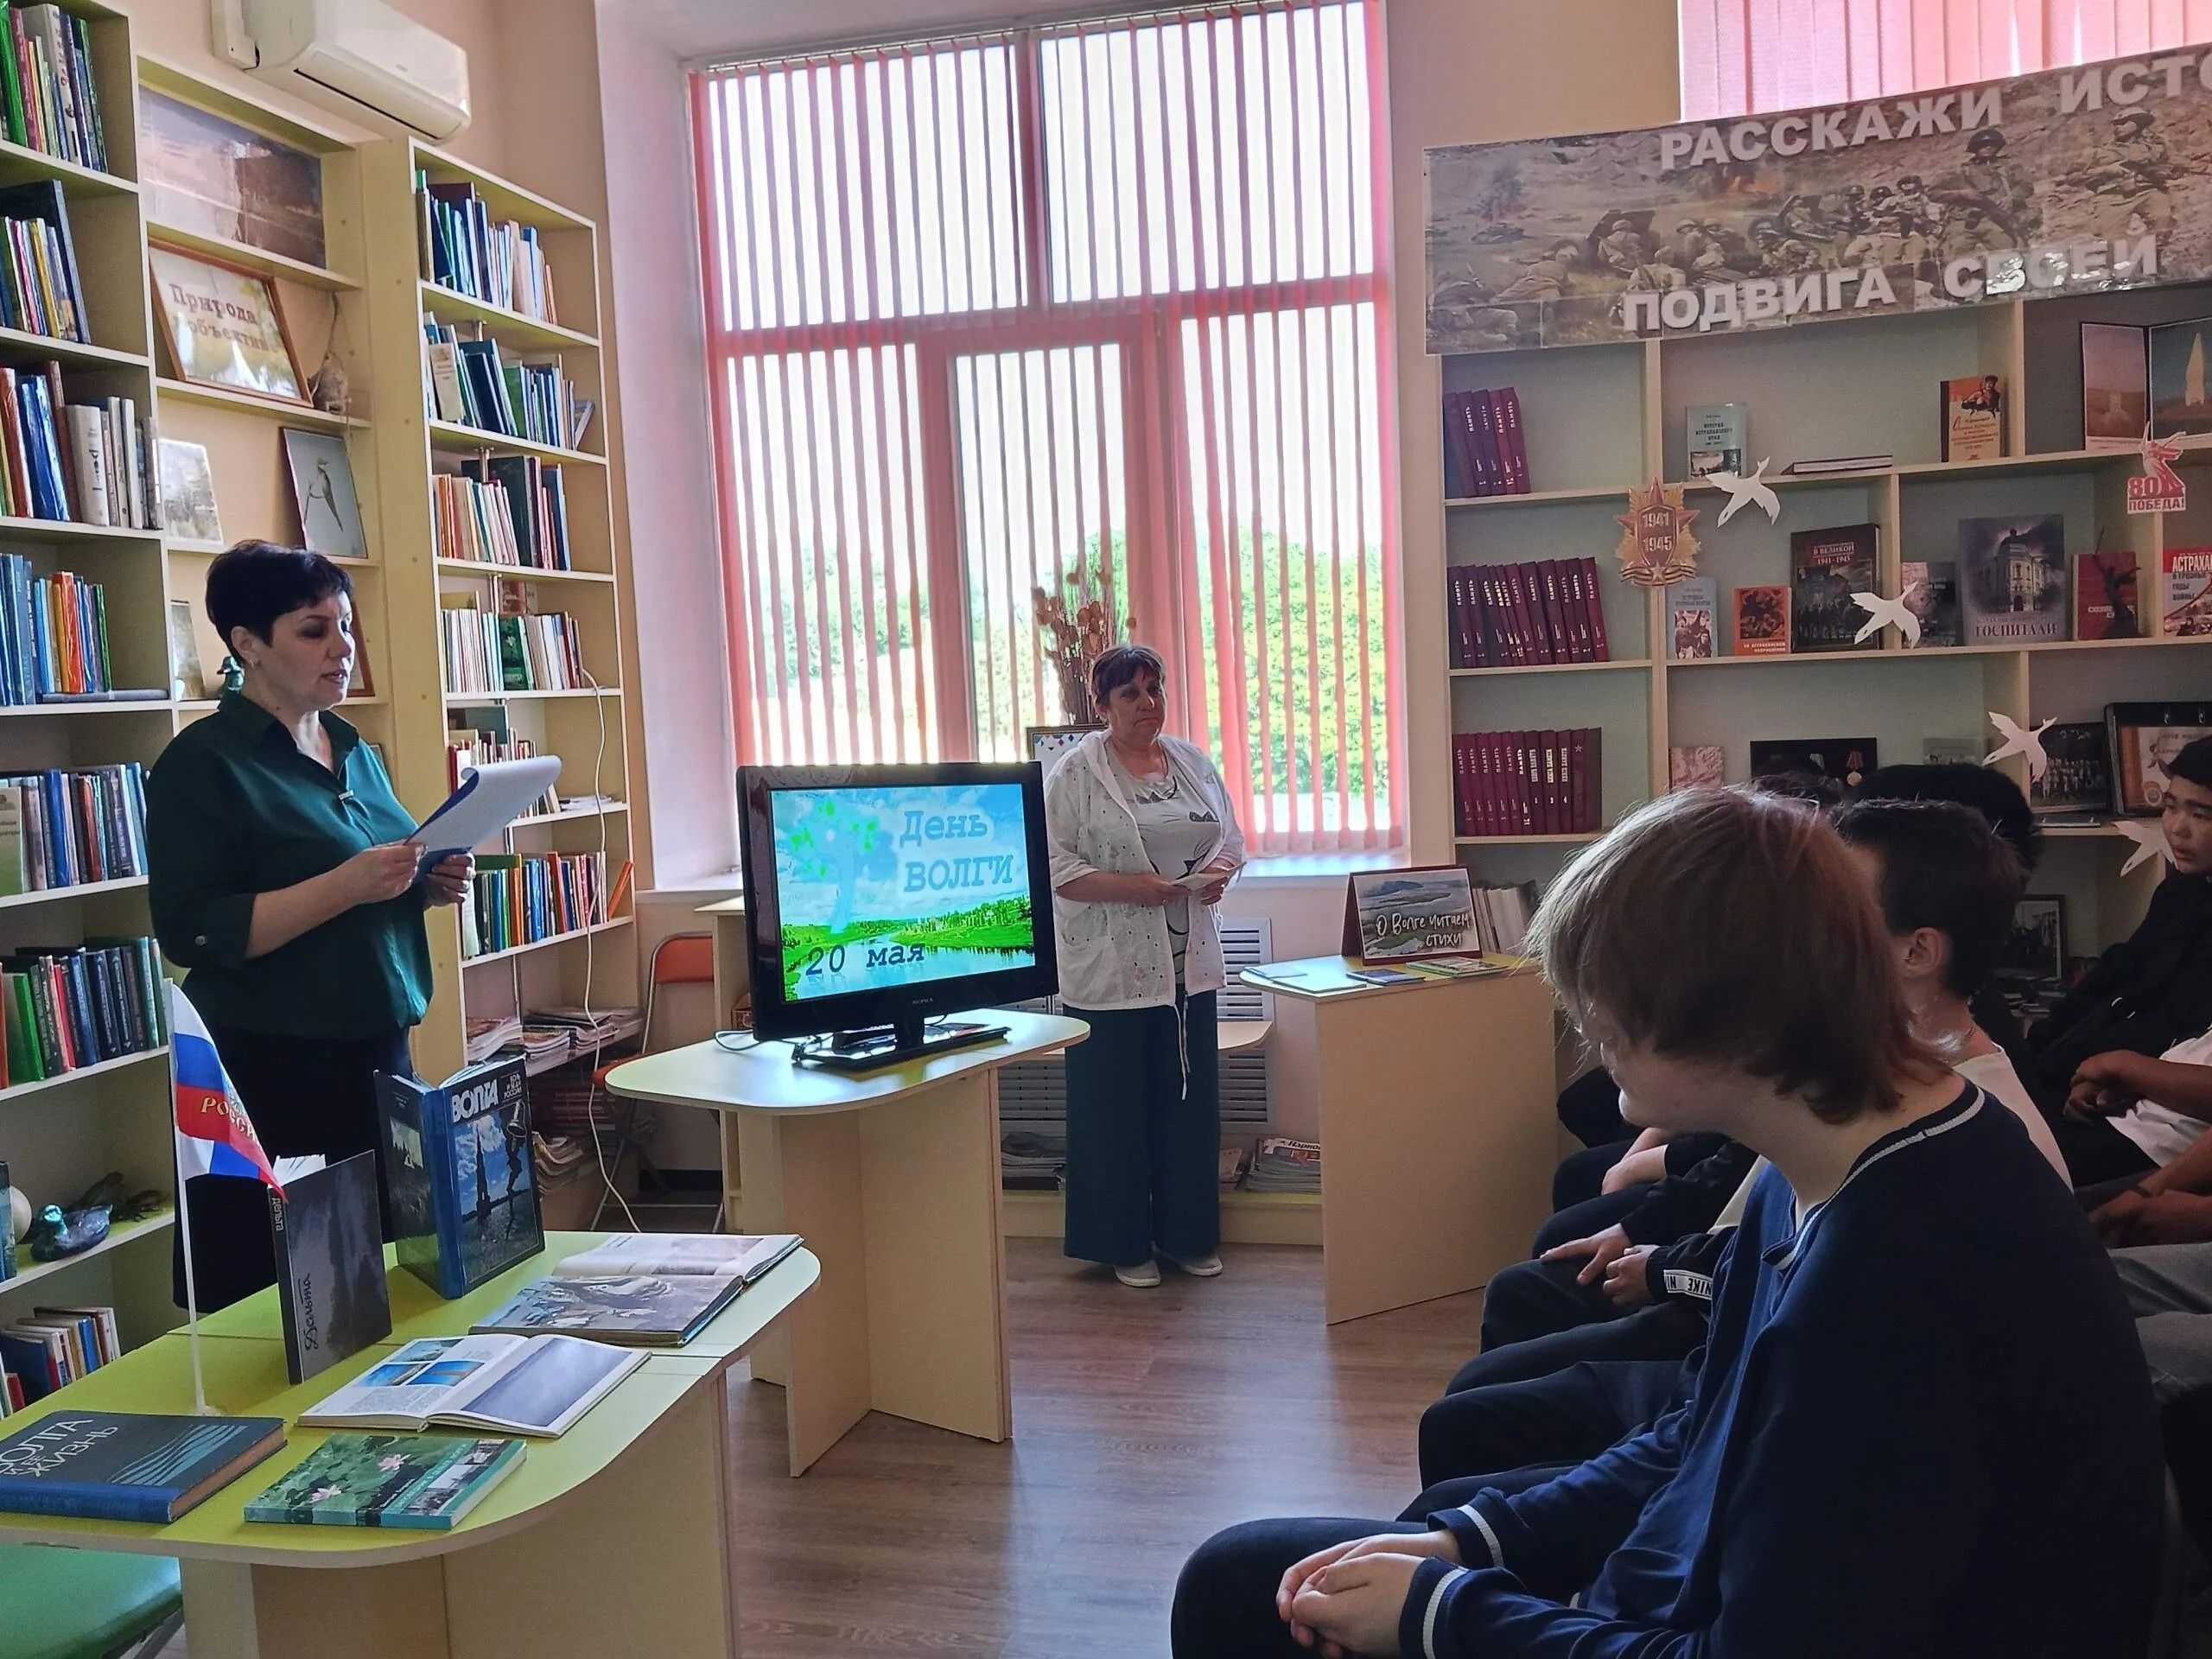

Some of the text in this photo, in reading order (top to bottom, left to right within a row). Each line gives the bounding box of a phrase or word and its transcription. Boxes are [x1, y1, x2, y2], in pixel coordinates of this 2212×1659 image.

[1659, 86, 2002, 170] РАССКАЖИ
[168, 283, 258, 326] Природа
[1624, 266, 1897, 333] ПОДВИГА
[1507, 400, 1516, 429] ПАМЯТЬ
[2128, 476, 2159, 497] 80
[1643, 511, 1670, 528] 1941
[2129, 498, 2185, 512] ПОБЕДА!
[1643, 536, 1673, 553] 1945
[1484, 580, 1493, 606] ПАМЯТЬ
[1495, 580, 1504, 607] ПАМЯТЬ
[1547, 575, 1555, 601] ПАМЯТЬ
[1573, 574, 1581, 600] ПАМЯТЬ
[899, 810, 988, 849] День
[904, 855, 1014, 893] ВОЛГИ
[1376, 914, 1388, 936] О
[1392, 912, 1427, 935] Волге
[804, 943, 926, 976] 20 мая
[451, 1078, 499, 1122] ВОЛГА
[200, 1096, 261, 1147] РОССИ
[1687, 1277, 1713, 1295] NIKE
[298, 1273, 320, 1351] Дельта
[17, 1426, 118, 1478] ЖИЗНЬ
